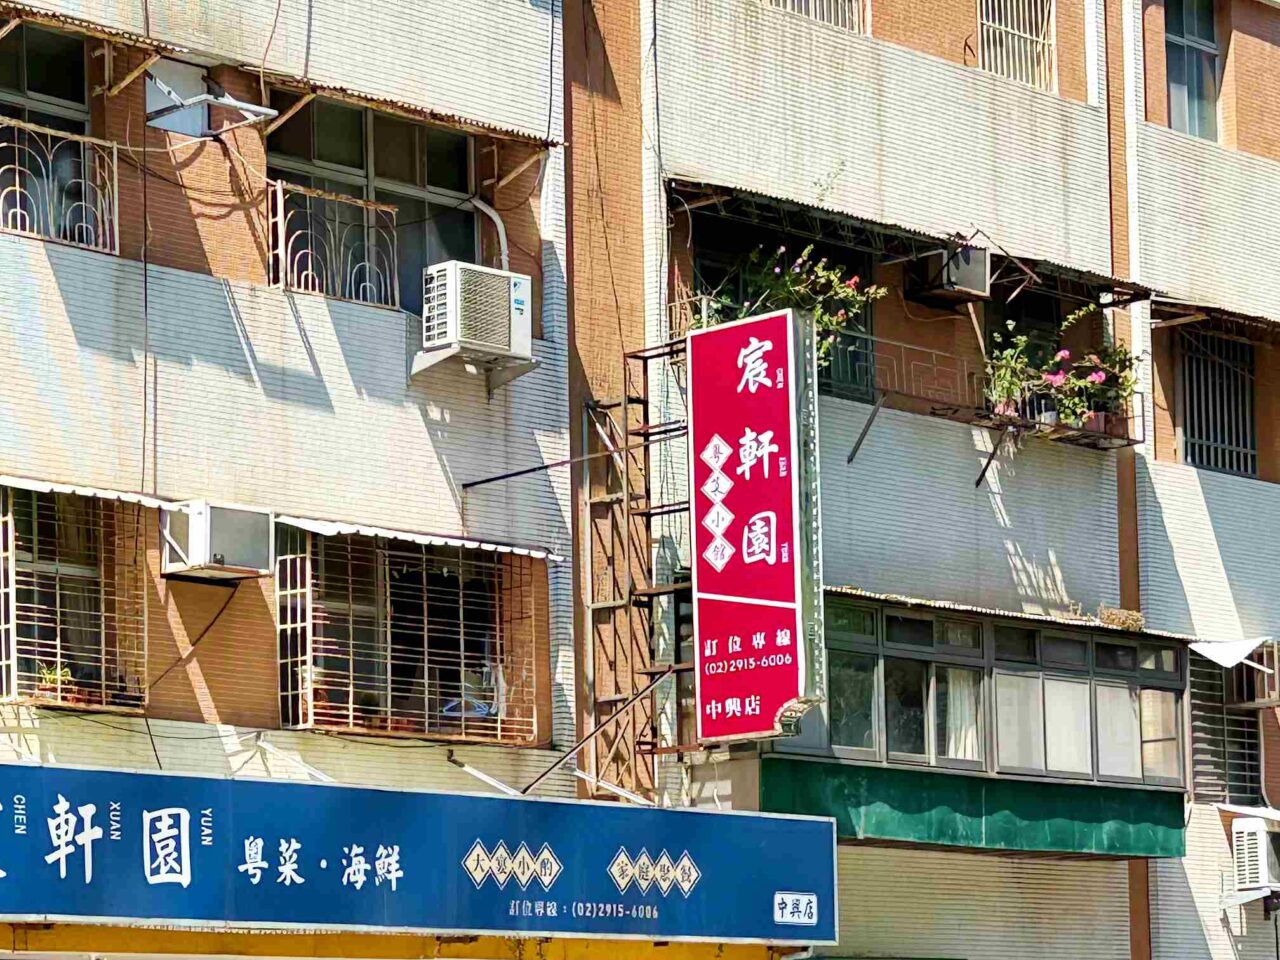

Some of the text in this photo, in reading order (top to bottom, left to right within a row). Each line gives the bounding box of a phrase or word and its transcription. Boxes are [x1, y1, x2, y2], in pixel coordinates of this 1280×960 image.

[736, 337, 780, 565] 宸軒園
[705, 653, 793, 675] (02)2915-6006
[706, 695, 760, 720] 中興店
[12, 794, 27, 835] CHEN
[109, 801, 121, 840] XUAN
[200, 808, 213, 846] YUAN
[778, 897, 814, 920] 中興店
